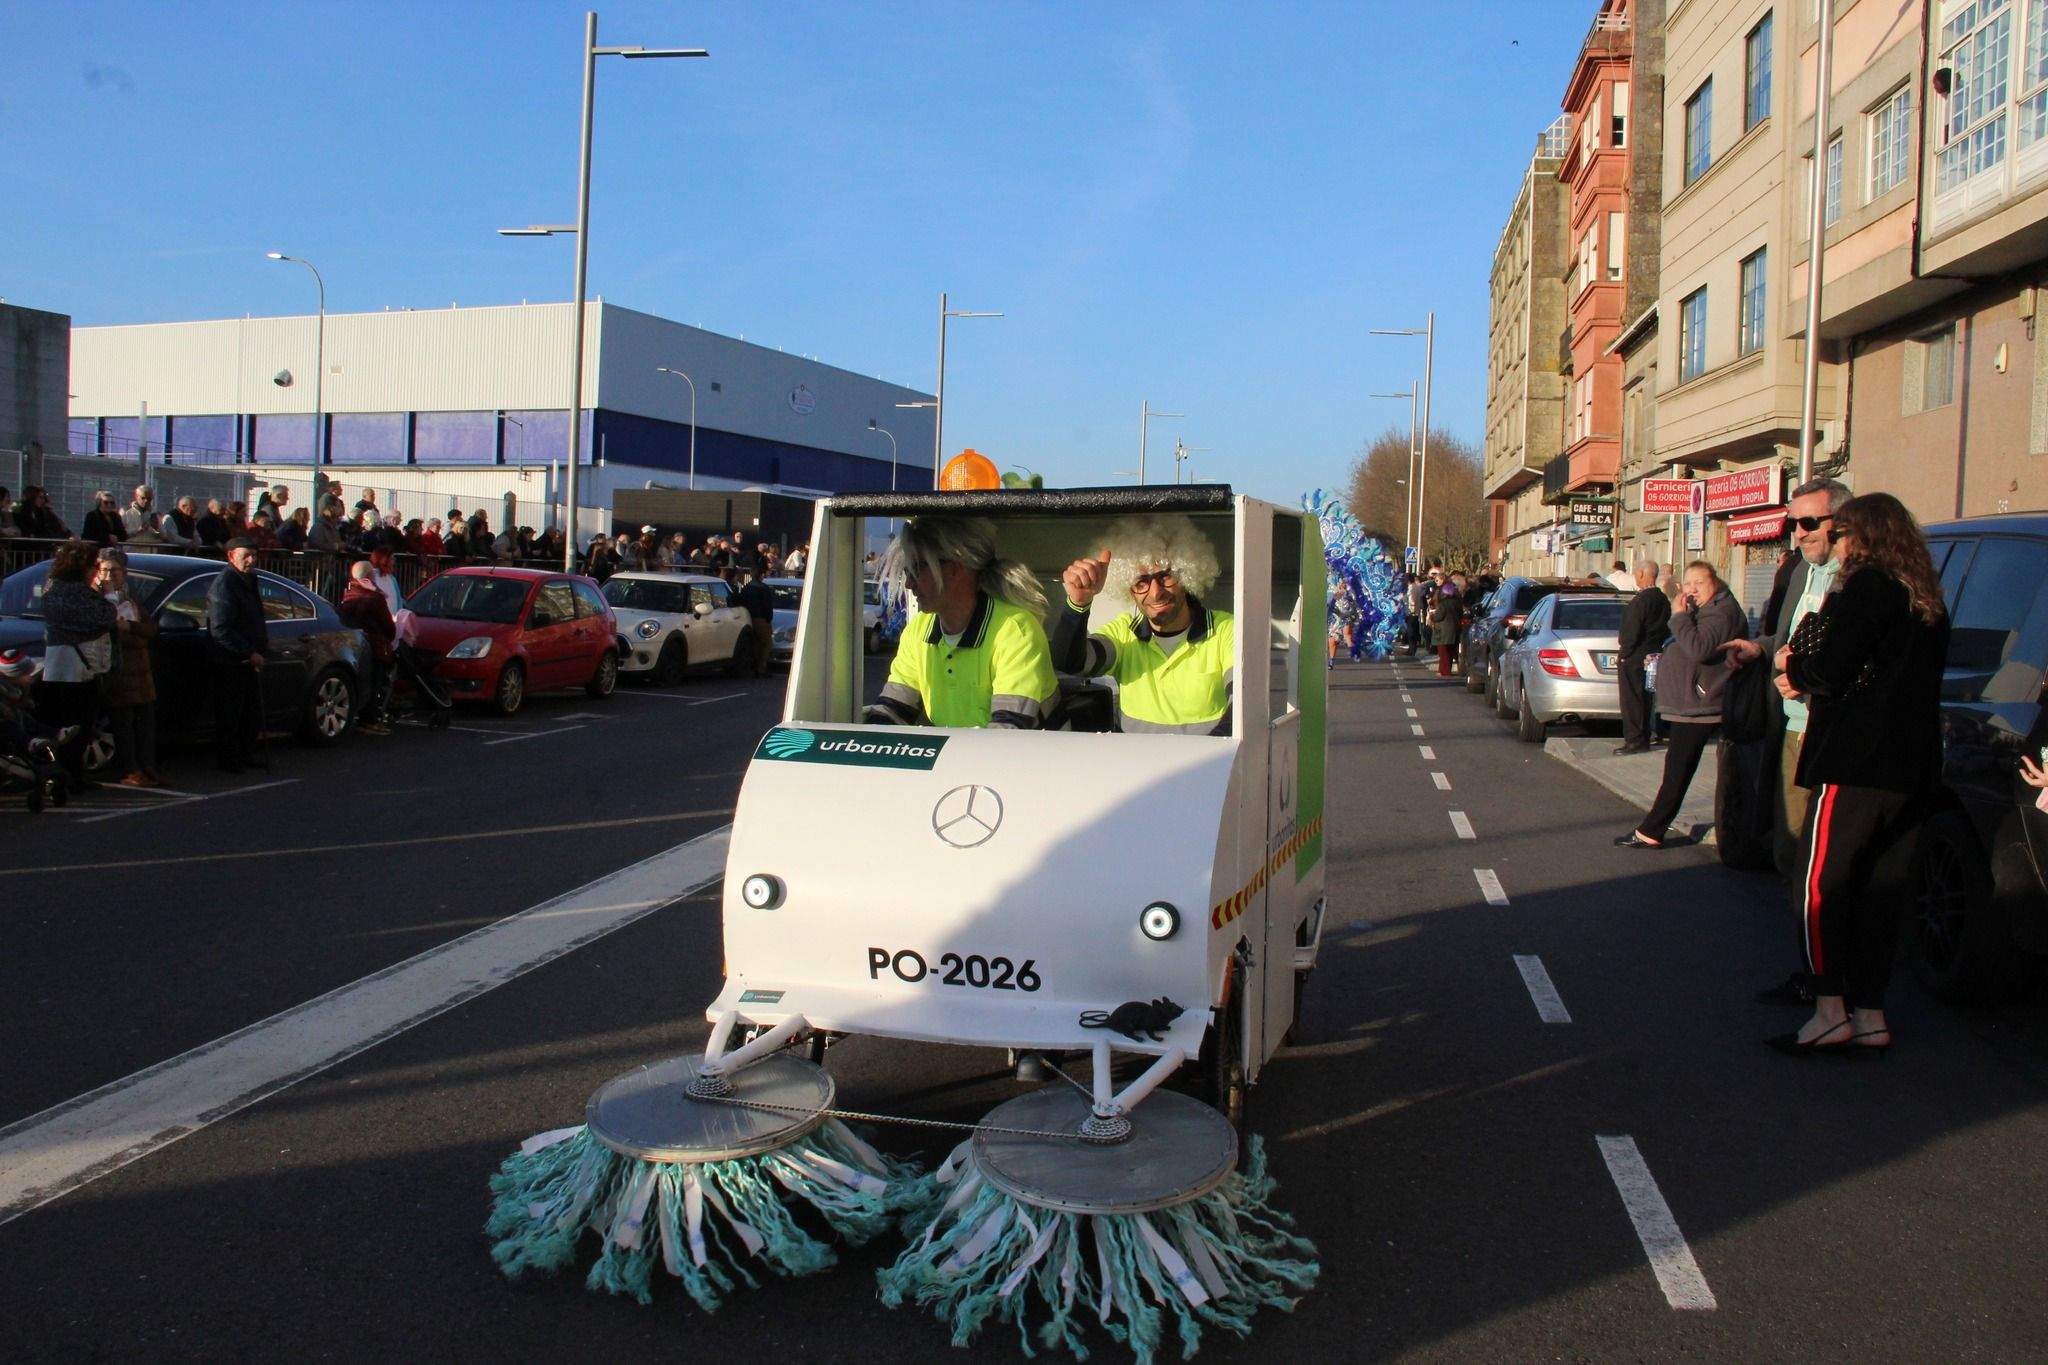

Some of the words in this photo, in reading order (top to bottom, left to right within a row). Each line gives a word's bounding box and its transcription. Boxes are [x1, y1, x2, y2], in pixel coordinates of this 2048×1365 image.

[1647, 493, 1658, 501] OS
[1742, 491, 1764, 504] PROPIA
[1597, 505, 1613, 514] BAR
[1573, 514, 1612, 524] BRECA
[820, 738, 937, 758] urbanitas
[868, 947, 1041, 992] PO-2026
